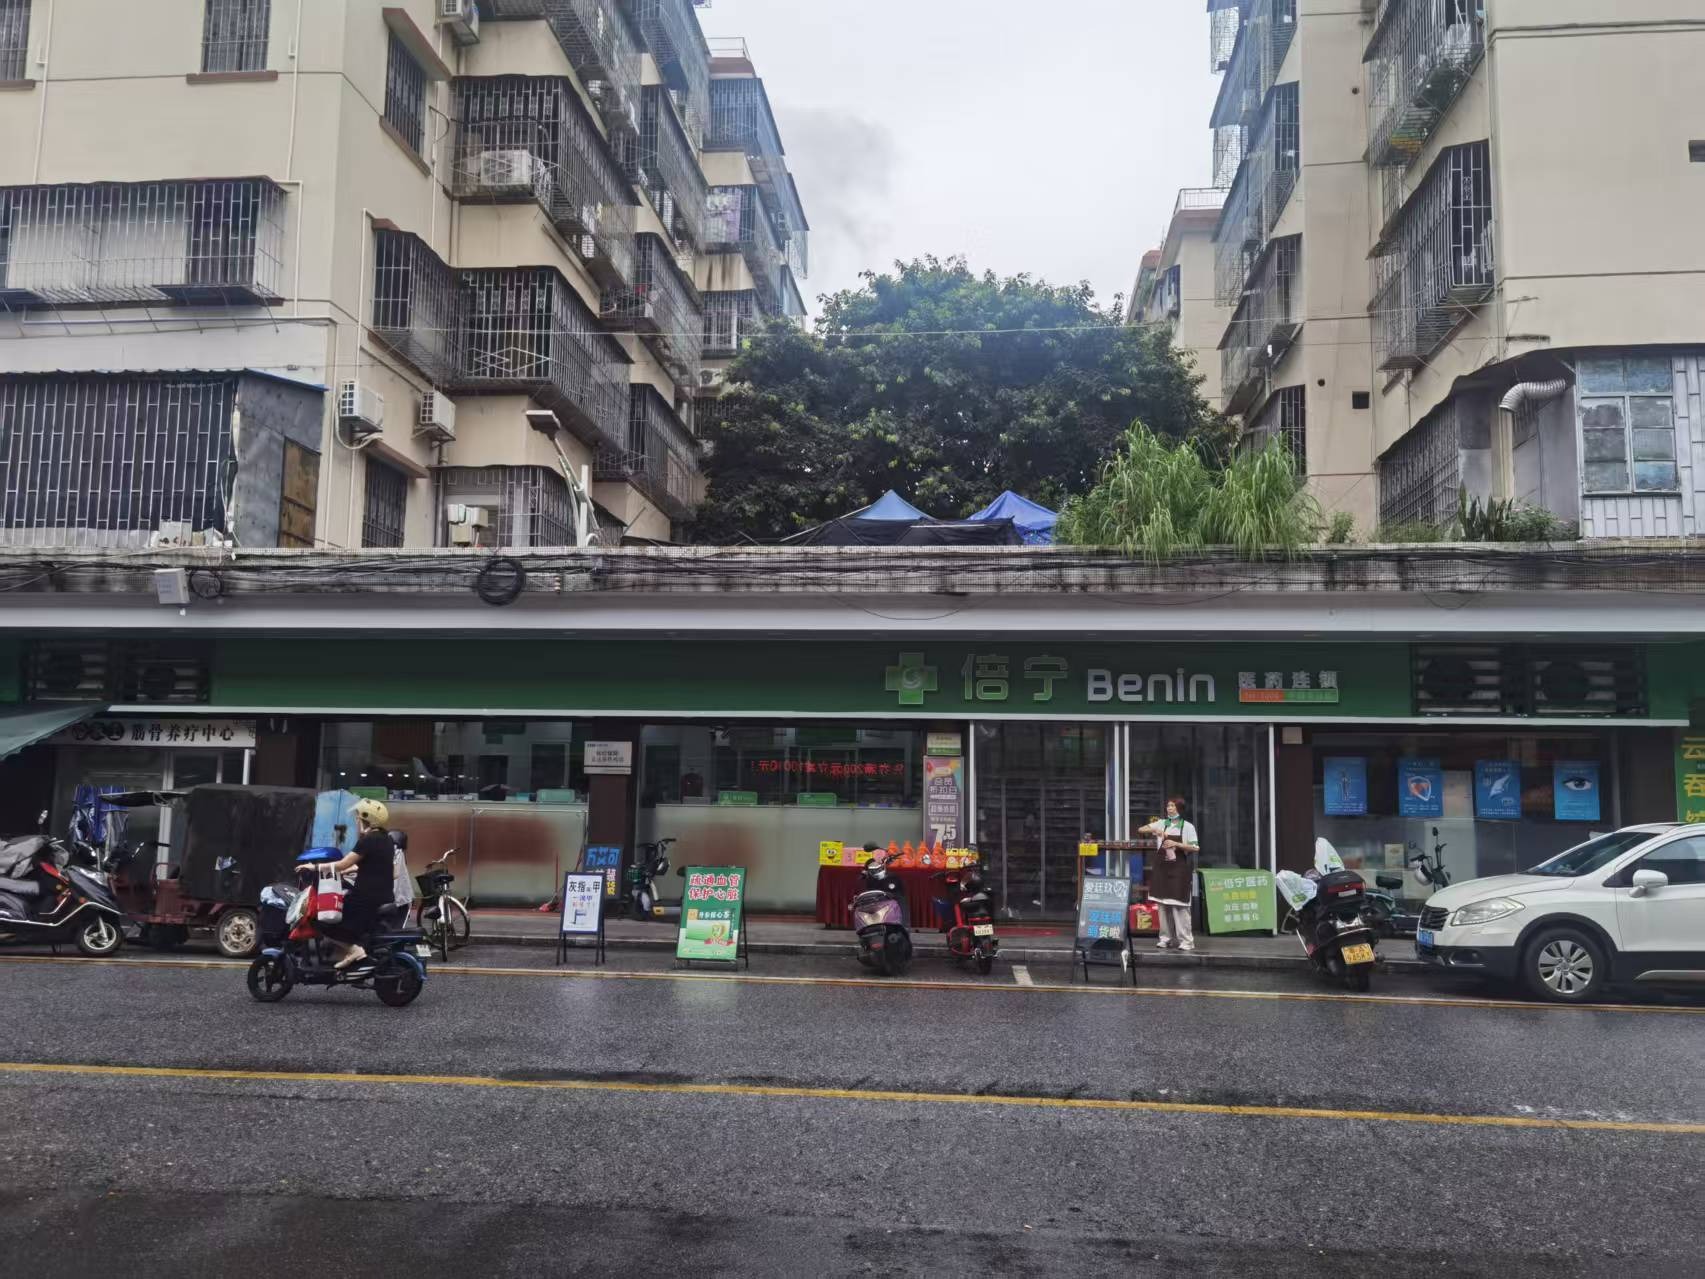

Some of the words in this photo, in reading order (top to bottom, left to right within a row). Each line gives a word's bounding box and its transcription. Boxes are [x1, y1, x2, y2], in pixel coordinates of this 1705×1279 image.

[1087, 667, 1215, 702] Benin
[689, 873, 741, 887] 疏通血管
[688, 887, 739, 901] 保护心脏
